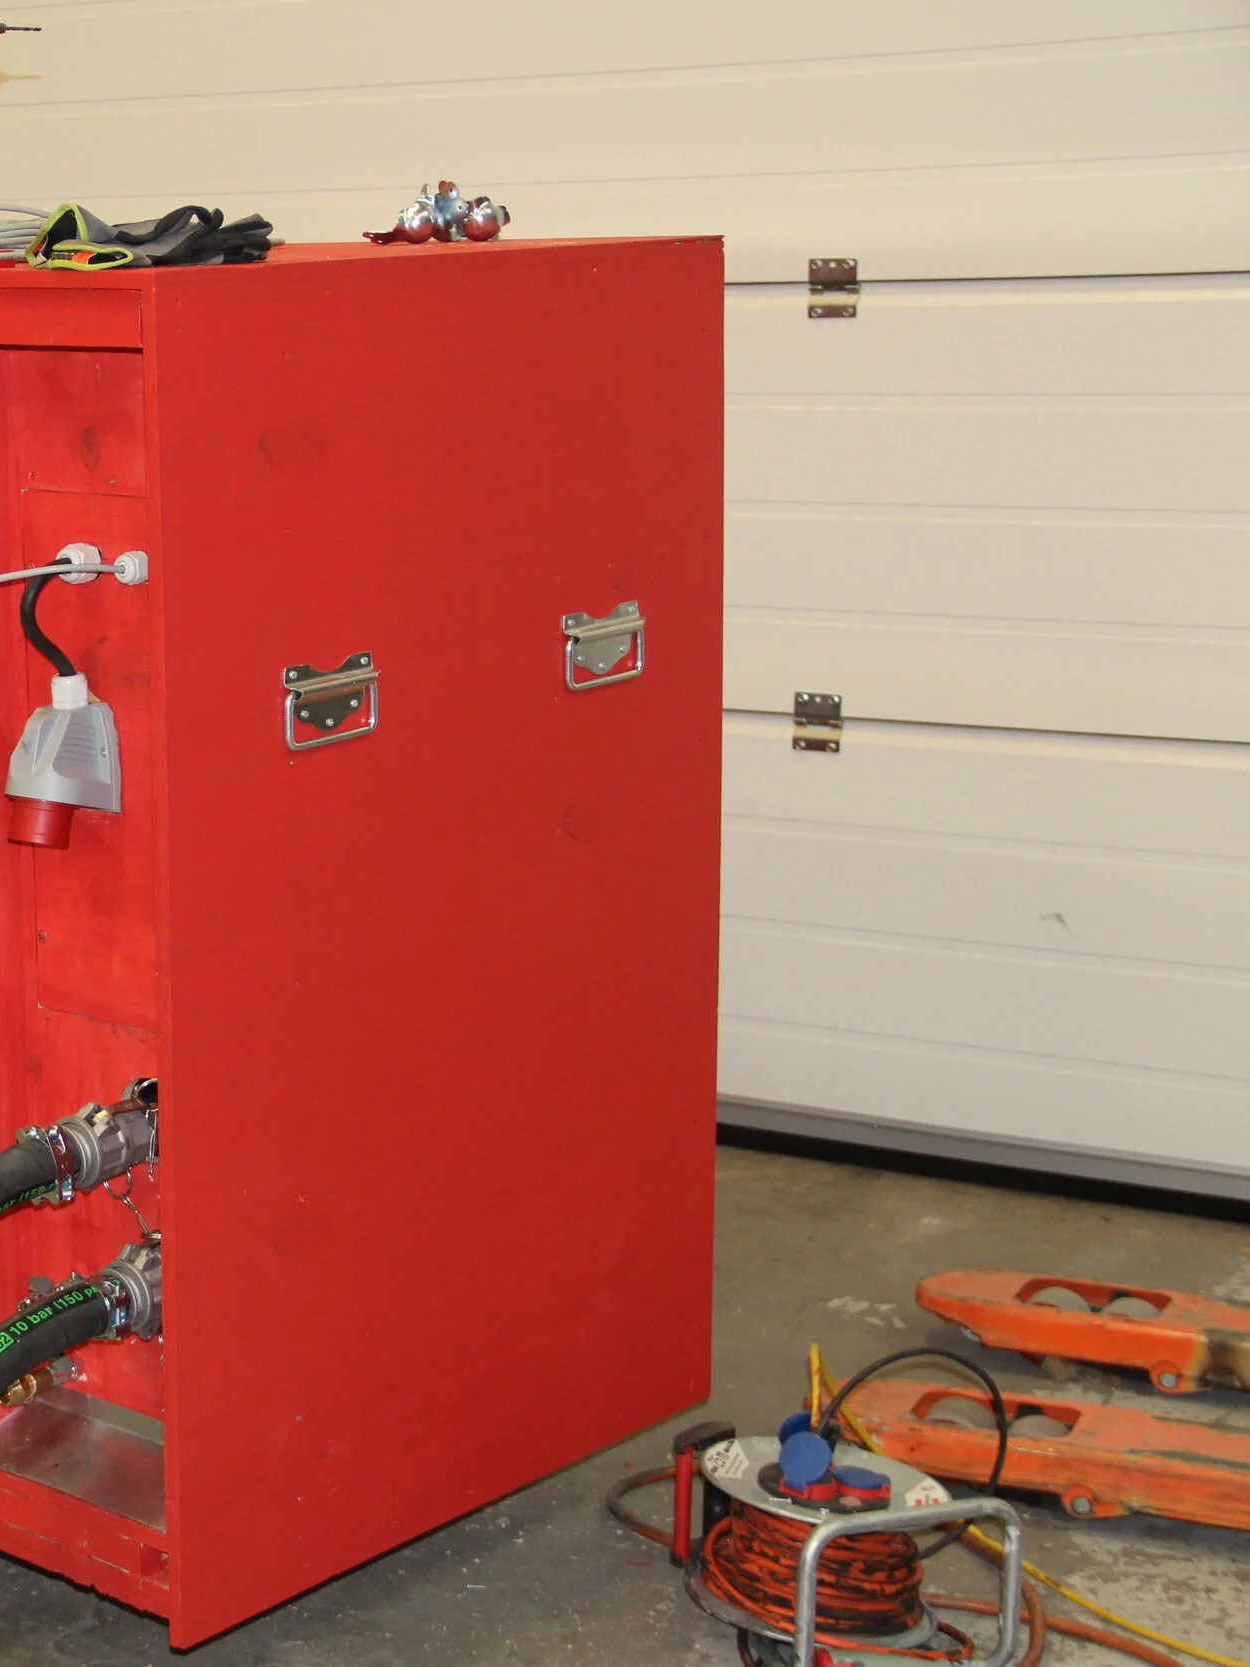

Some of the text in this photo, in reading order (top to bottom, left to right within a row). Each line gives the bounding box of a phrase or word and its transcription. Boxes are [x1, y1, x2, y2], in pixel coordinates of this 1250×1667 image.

[10, 1320, 29, 1336] 10
[27, 1305, 53, 1325] bar
[52, 1290, 84, 1310] (150
[83, 1285, 100, 1298] ps
